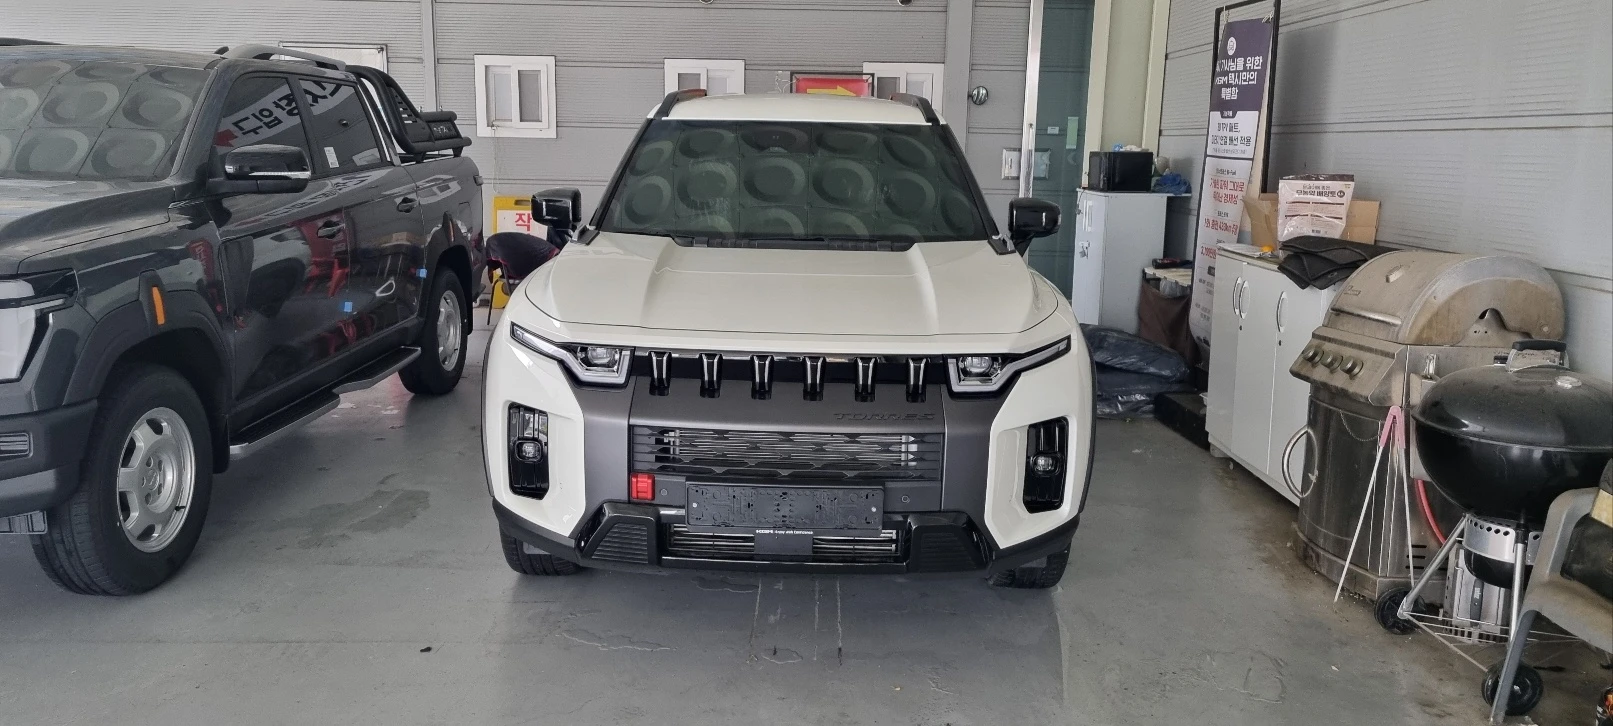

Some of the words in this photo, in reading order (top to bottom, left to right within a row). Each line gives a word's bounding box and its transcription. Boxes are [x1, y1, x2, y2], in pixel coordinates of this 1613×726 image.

[1246, 56, 1263, 70] 위한
[1228, 72, 1257, 85] 택시만의
[1221, 87, 1238, 100] 특별함
[833, 413, 936, 421] TORRES
